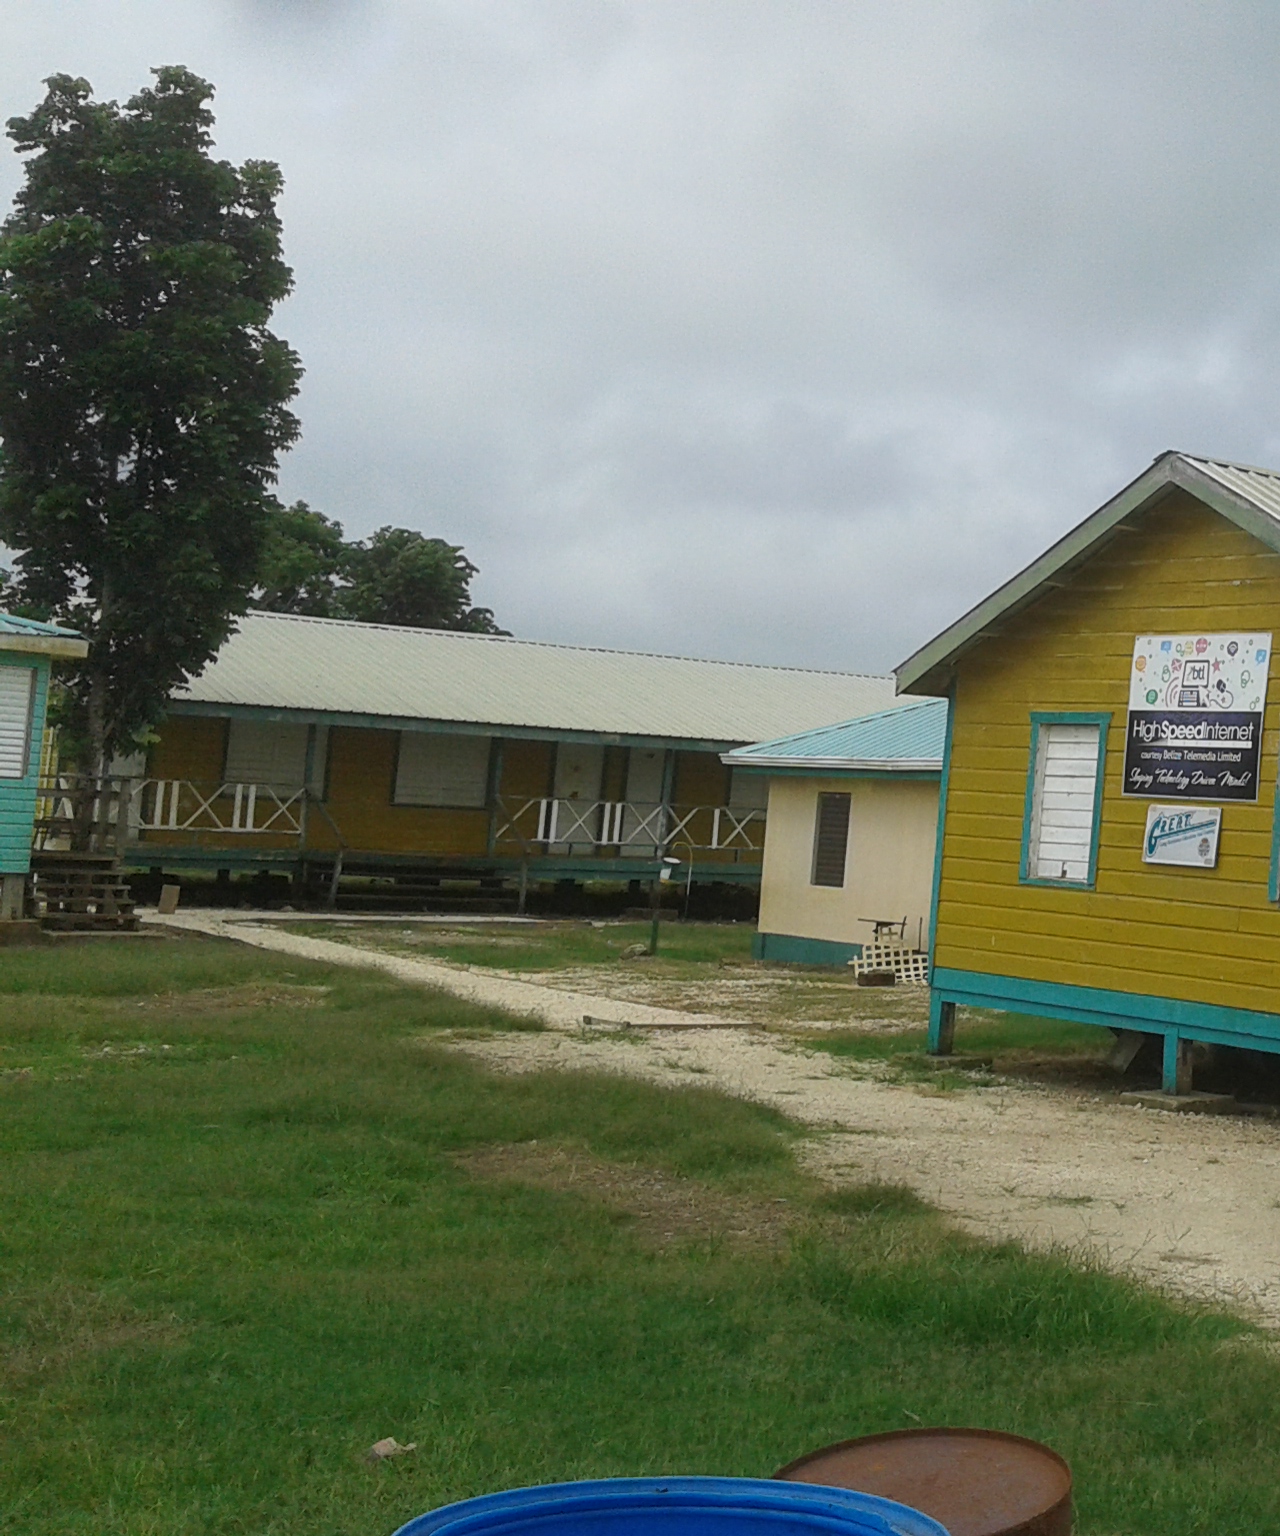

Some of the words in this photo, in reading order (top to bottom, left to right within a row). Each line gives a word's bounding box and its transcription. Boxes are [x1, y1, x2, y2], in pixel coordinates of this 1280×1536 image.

[1140, 751, 1162, 761] courtesy
[1163, 749, 1182, 761] Belize
[1183, 749, 1216, 762] Telemedia
[1217, 751, 1241, 762] Limited
[1155, 768, 1190, 790] Technology
[1191, 770, 1216, 785] Driven
[1147, 812, 1193, 855] GREAT
